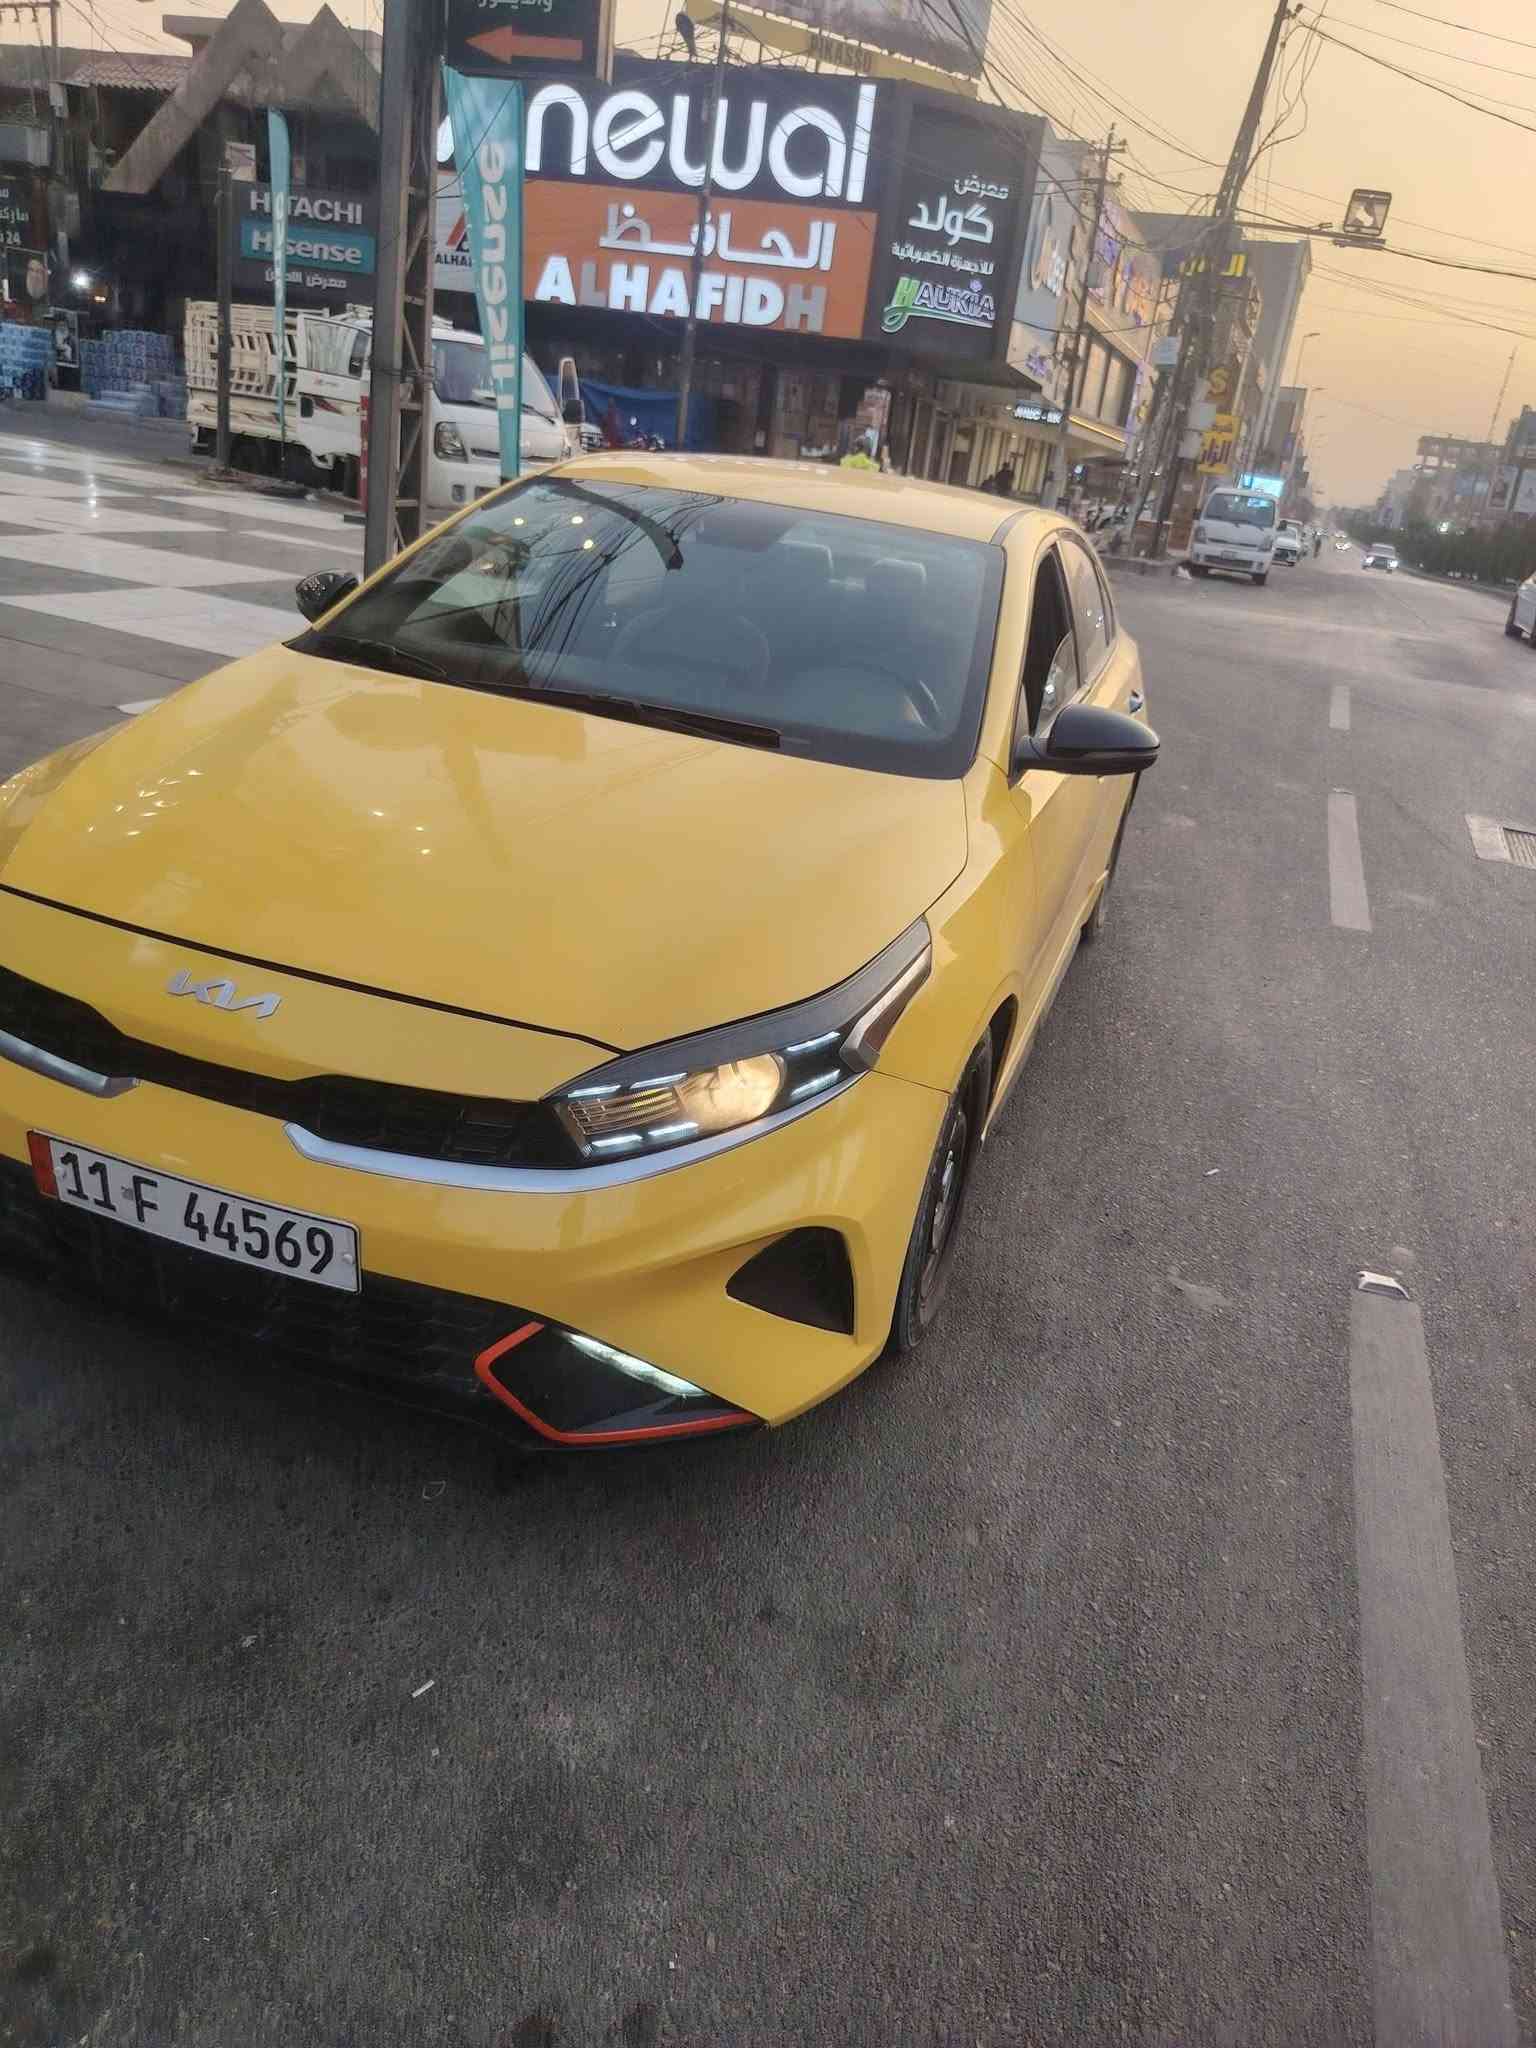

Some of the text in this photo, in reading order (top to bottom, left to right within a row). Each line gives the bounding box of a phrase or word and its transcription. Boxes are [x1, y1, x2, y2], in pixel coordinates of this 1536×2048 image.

[525, 83, 877, 203] newal
[250, 189, 362, 225] HTACHI
[953, 174, 1009, 200] معرض
[251, 229, 362, 265] Hsense
[534, 255, 828, 334] ALHAFIDH
[60, 1151, 334, 1275] 11 F 44569
